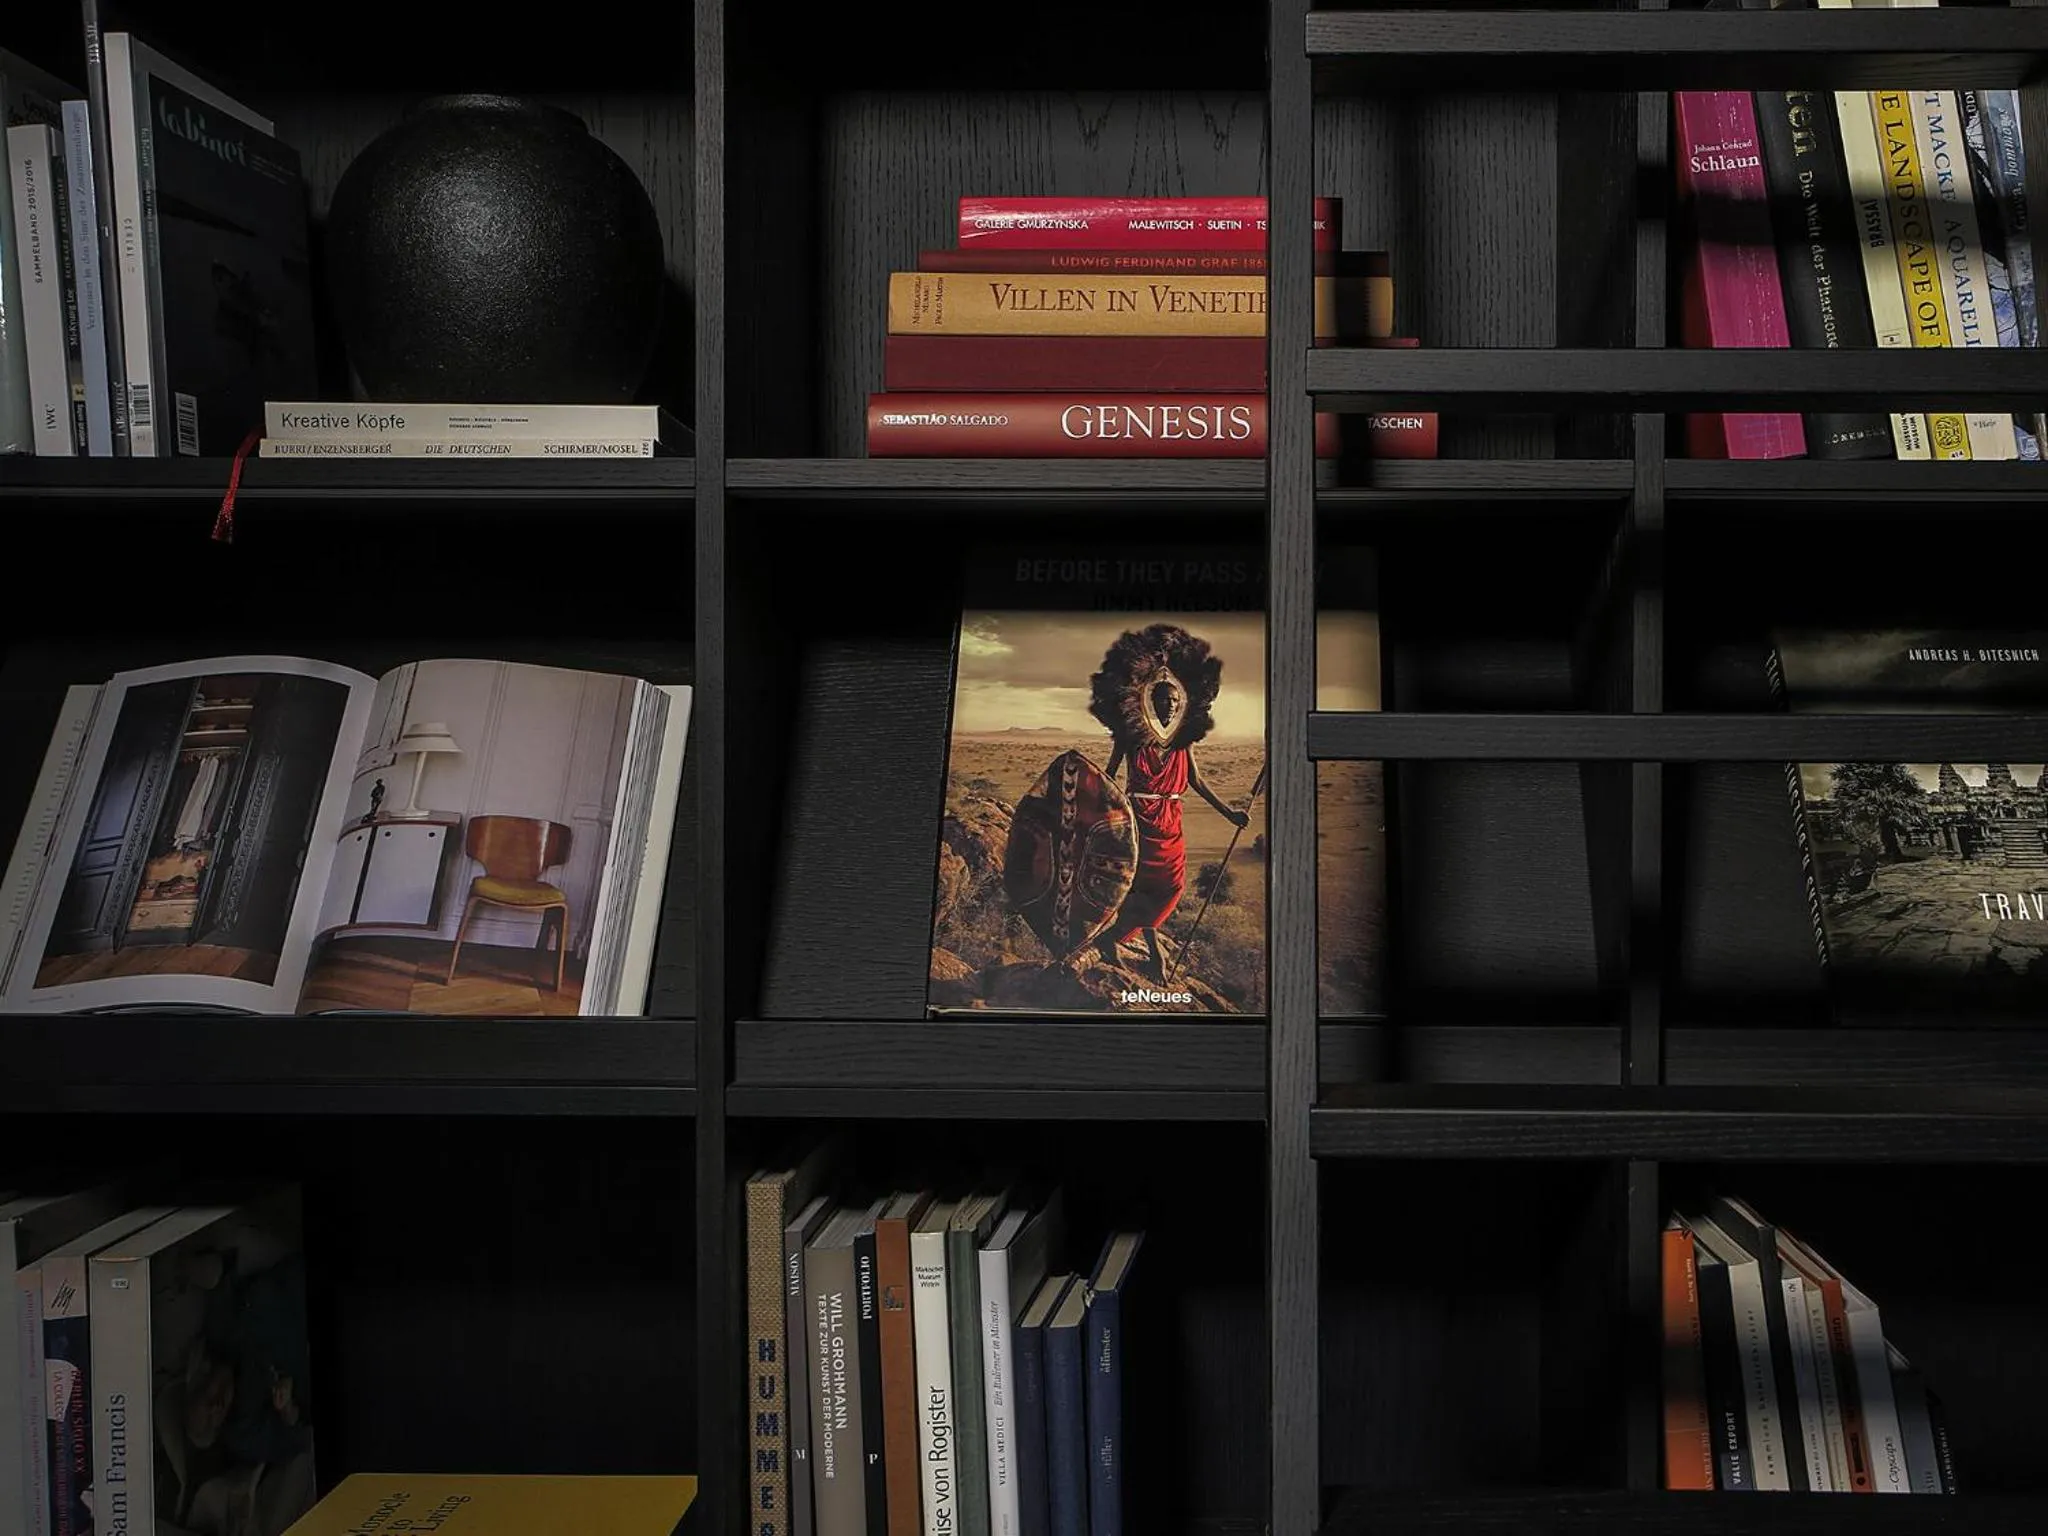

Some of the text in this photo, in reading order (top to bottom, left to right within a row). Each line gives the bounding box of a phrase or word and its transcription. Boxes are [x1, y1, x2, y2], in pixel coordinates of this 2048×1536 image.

[1694, 140, 1752, 153] Johann Conrad
[1927, 115, 1956, 201] MACKE
[1998, 108, 2019, 177] hommages
[1690, 154, 1760, 174] Schlaun
[1798, 170, 1817, 199] Die
[26, 158, 43, 284] SAMMELBAND 2015/2016
[974, 218, 1015, 230] GALERIE
[1017, 219, 1089, 231] GMURZYNSKA
[1128, 218, 1194, 230] MALEWITSCH
[1207, 218, 1242, 230] SUETIN
[1804, 202, 1825, 239] Welt
[1886, 119, 1933, 293] LANDSCAPE
[1918, 301, 1941, 337] OF
[1051, 255, 1111, 268] LUDWIG
[1114, 255, 1196, 268] FERDINAND
[1200, 257, 1239, 269] GRAF
[1811, 244, 1828, 270] der
[989, 282, 1096, 313] VILLEN
[1108, 289, 1138, 313] IN
[45, 403, 58, 430] IWC
[281, 412, 405, 432] Kreative Köpfe
[882, 411, 1009, 426] SEBASTIÃO SALGADO
[1060, 403, 1253, 441] GENESIS
[1366, 416, 1424, 431] TASCHEN
[425, 443, 445, 455] DIE
[449, 443, 513, 455] DEUTSCHEN
[543, 443, 638, 456] SCHIRMER/MOSEL
[1015, 558, 1108, 585] BEFORE
[1115, 558, 1177, 585] THEY
[1183, 558, 1248, 585] PASS
[1908, 647, 2041, 663] ANDREAS H. BITESNICH
[1978, 892, 2048, 922] TRAV
[1120, 989, 1193, 1006] teNeues
[789, 1252, 801, 1297] MAISON
[860, 1255, 873, 1320] PORTFOLIO
[988, 1300, 1001, 1339] Münster
[830, 1292, 848, 1430] WILL GROHMANN
[990, 1352, 1003, 1390] Italiener
[817, 1294, 835, 1479] TEXTE ZUR KUNST DER MODERNE
[993, 1390, 1003, 1407] Ein
[926, 1385, 952, 1462] Rogister
[995, 1416, 1005, 1453] MEDICI
[865, 1453, 878, 1465] P
[1726, 1411, 1742, 1485] VALIE EXPORT
[105, 1394, 128, 1536] Sam Francis
[997, 1457, 1007, 1486] VILLA
[934, 1467, 950, 1504] von
[410, 1494, 473, 1531] Living
